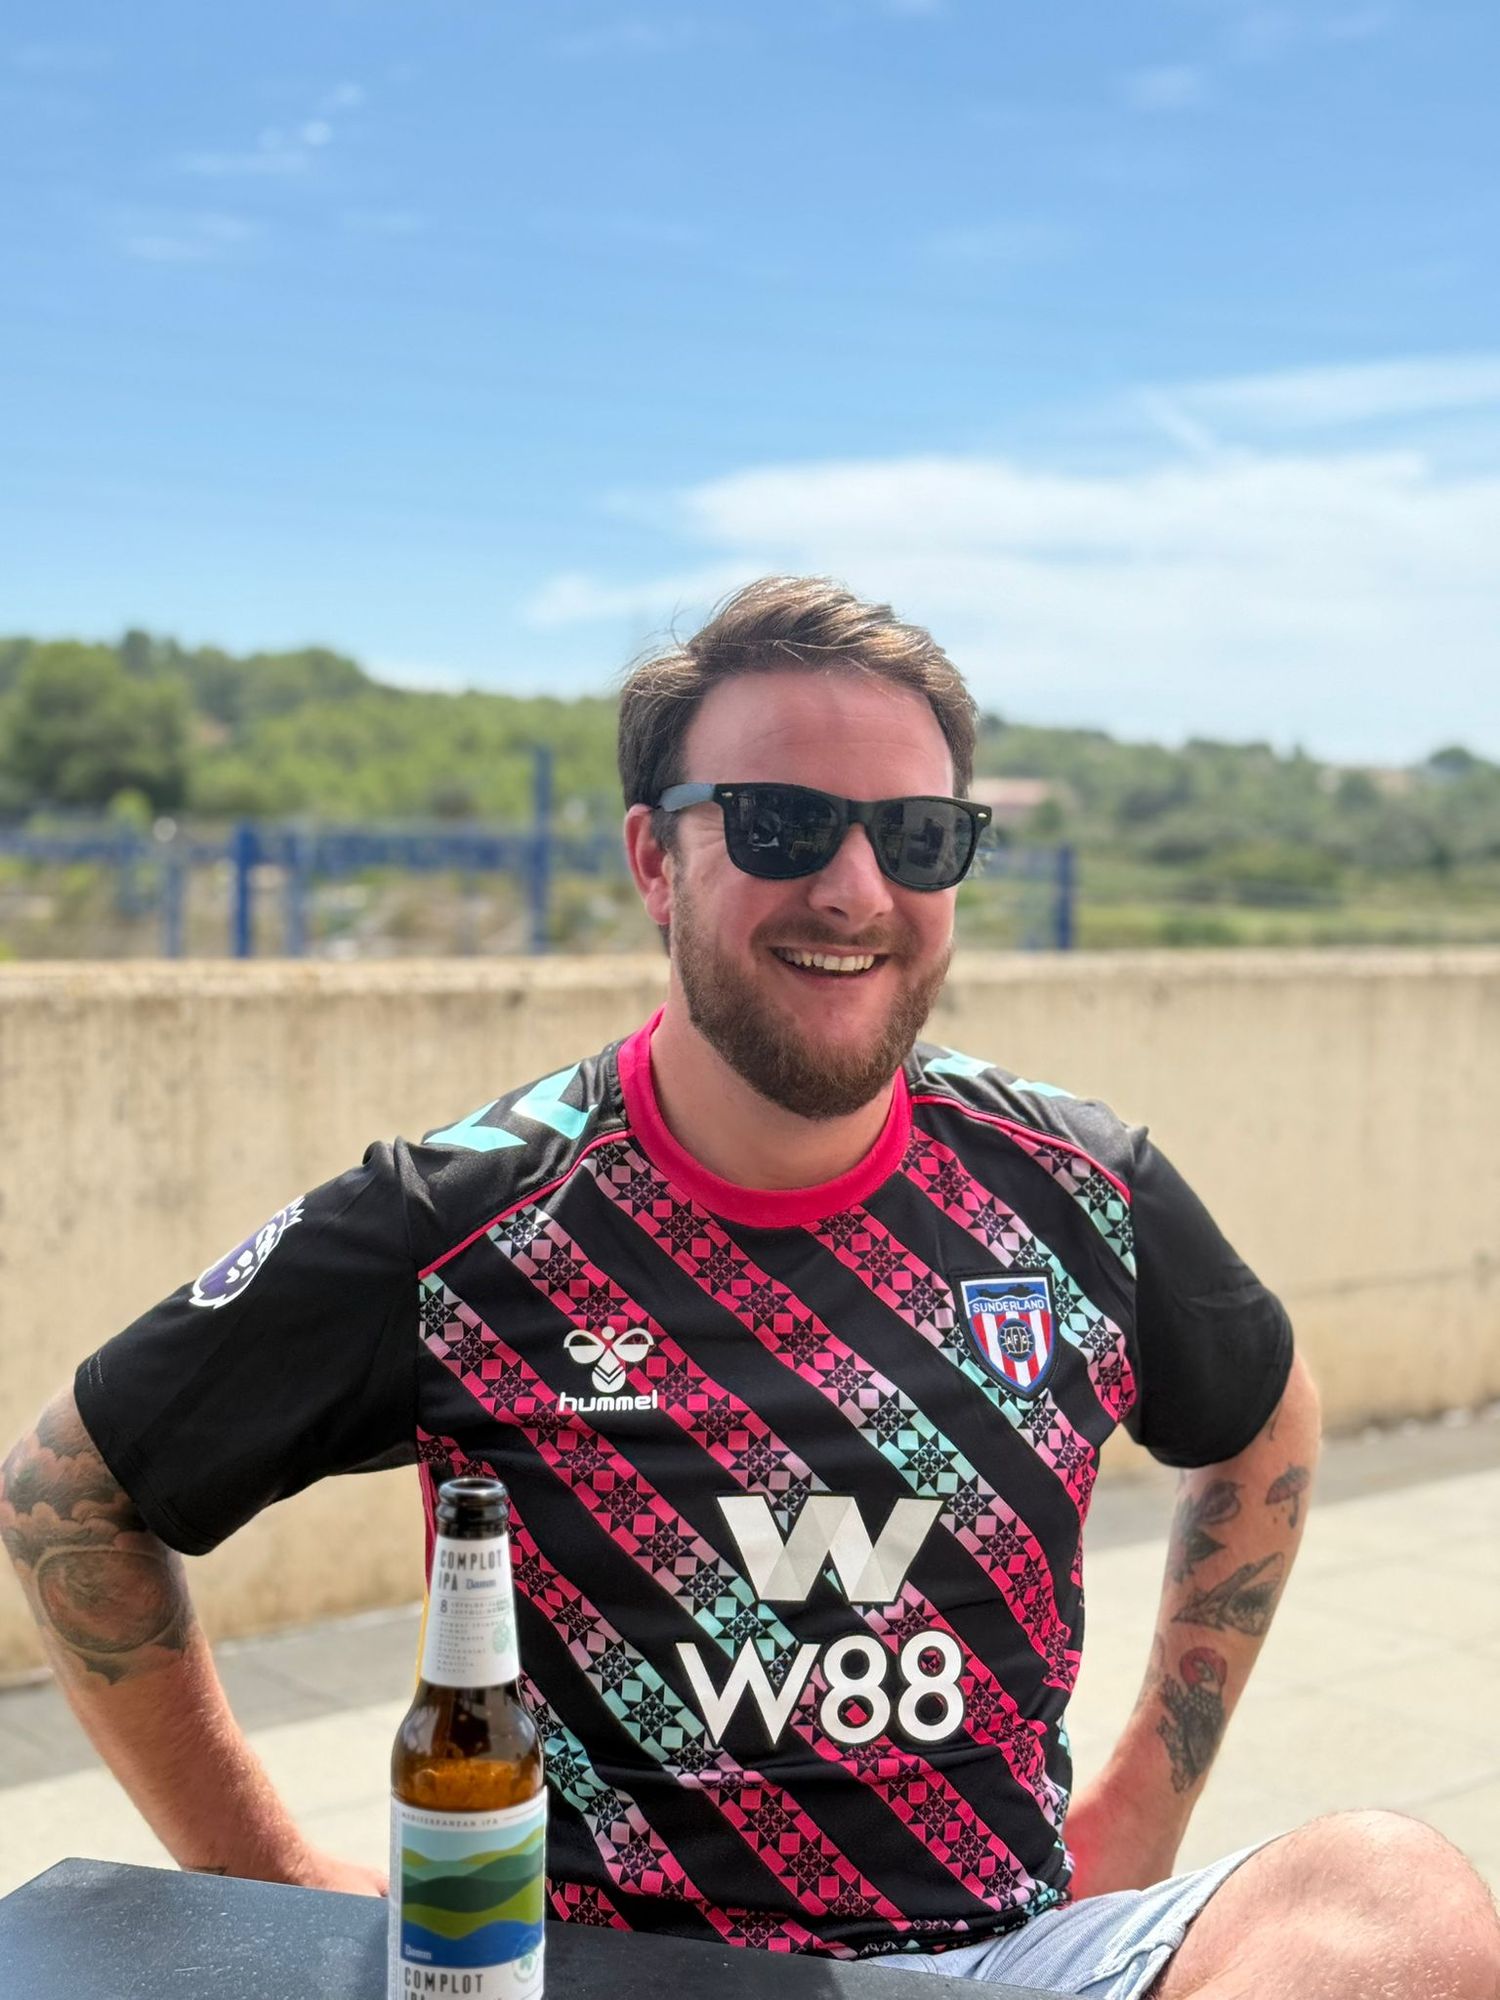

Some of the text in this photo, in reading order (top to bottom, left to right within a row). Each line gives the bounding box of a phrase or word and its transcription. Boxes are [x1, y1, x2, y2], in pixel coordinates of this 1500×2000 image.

[972, 1299, 1045, 1313] SUNDERLAND
[559, 1389, 658, 1412] hummel
[441, 1550, 502, 1570] COMPLOT
[438, 1570, 458, 1591] IPA
[440, 1600, 447, 1613] 8
[675, 1630, 964, 1745] W88
[404, 1966, 484, 1994] COMPLOT
